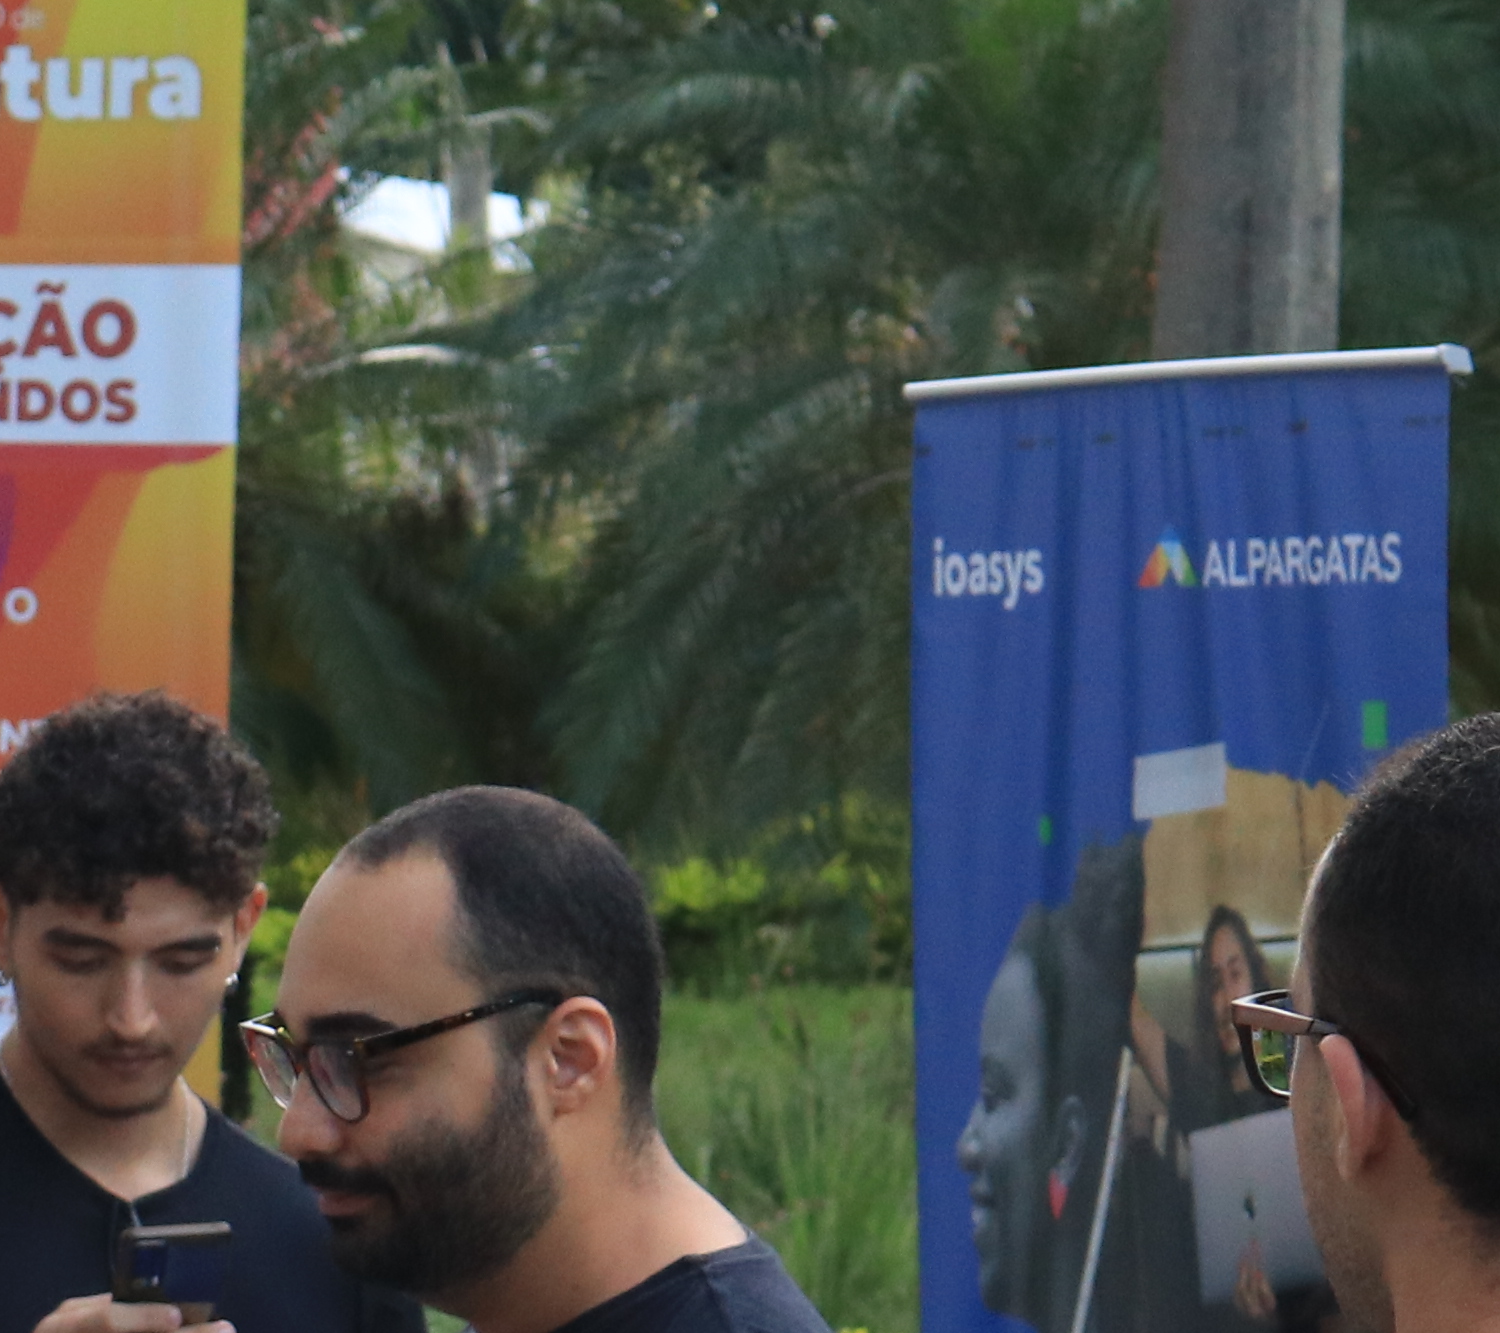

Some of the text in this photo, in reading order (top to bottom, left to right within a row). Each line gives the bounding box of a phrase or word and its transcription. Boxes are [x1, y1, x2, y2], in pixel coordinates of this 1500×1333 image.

[933, 531, 1402, 611] ioasys ALPARGATAS
[5, 587, 39, 623] O
